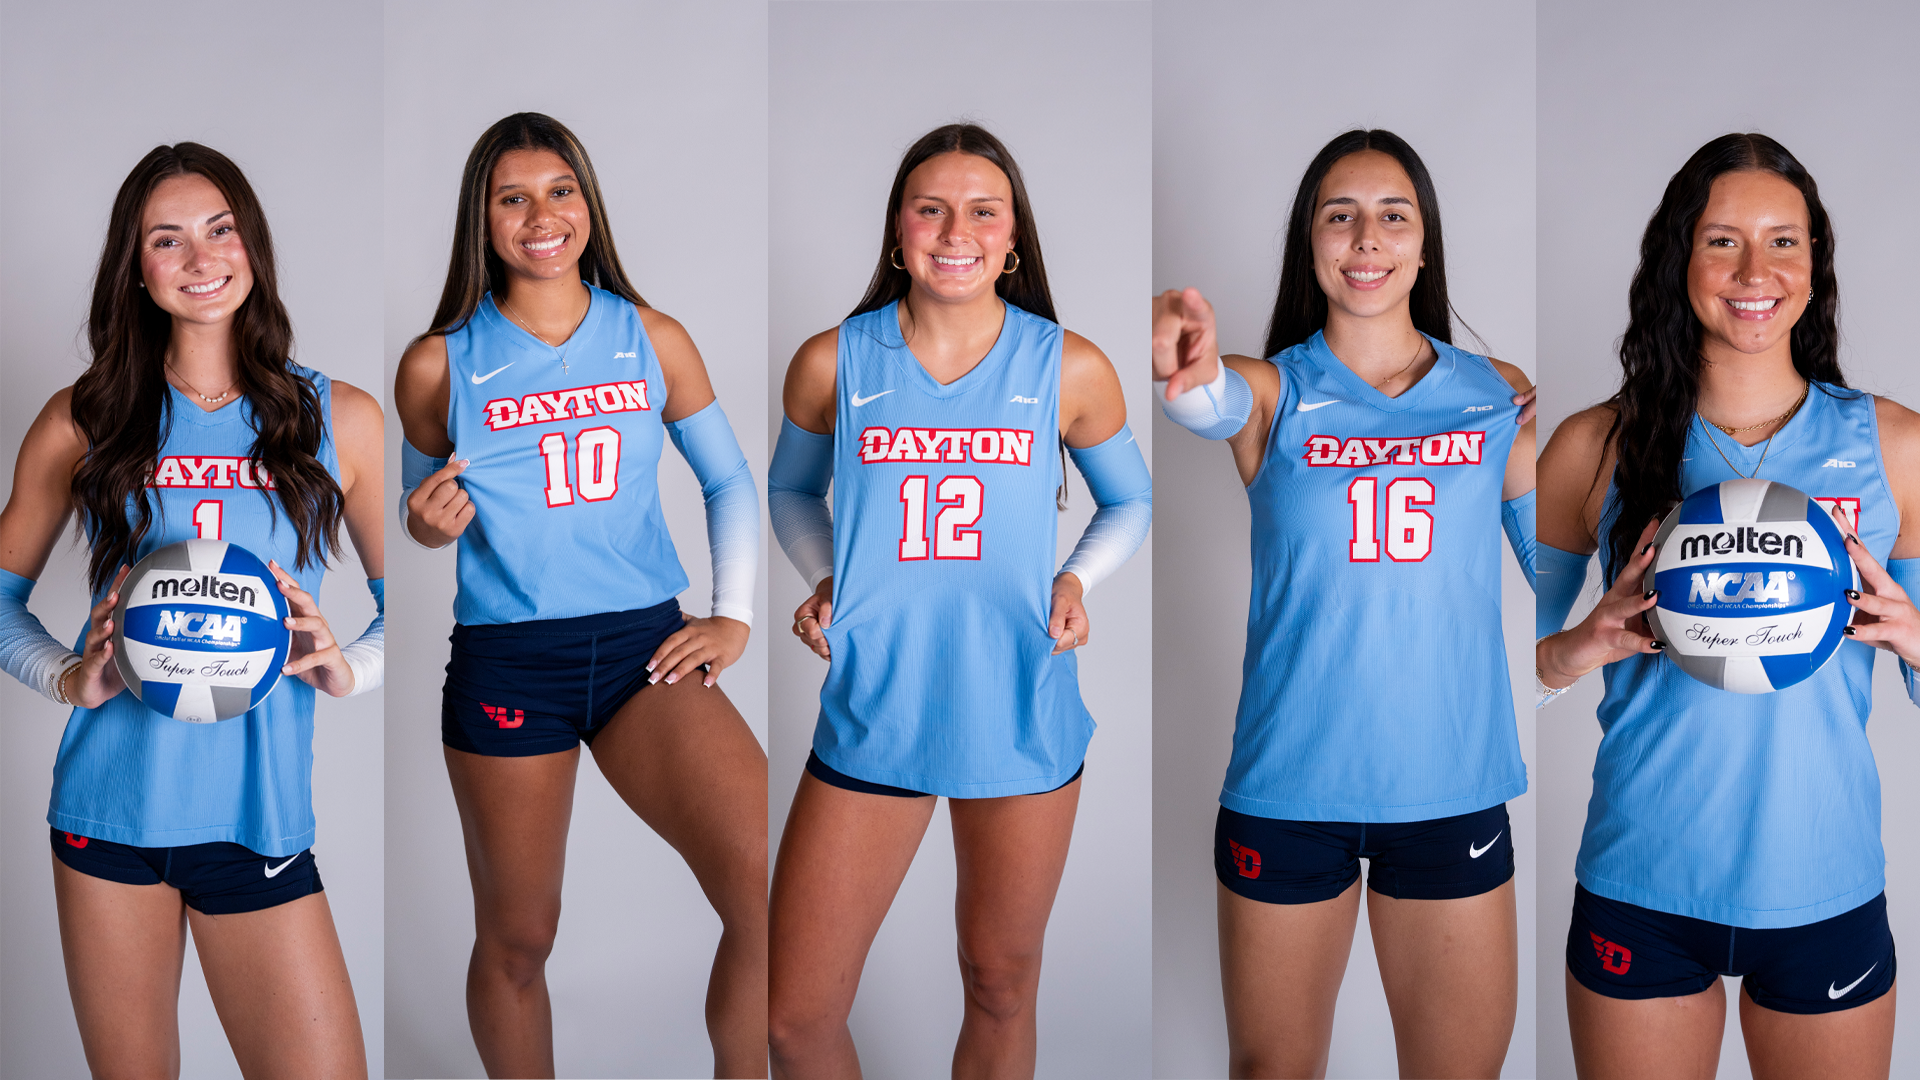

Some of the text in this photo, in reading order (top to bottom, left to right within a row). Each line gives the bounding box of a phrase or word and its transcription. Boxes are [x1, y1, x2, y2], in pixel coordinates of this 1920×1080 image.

[482, 379, 651, 432] DAYTON
[857, 426, 1034, 467] DAYTON
[1301, 430, 1486, 468] DAYTON
[144, 455, 279, 491] AYTO
[538, 425, 621, 508] 10
[192, 499, 223, 541] 1
[898, 474, 985, 562] 12
[1347, 476, 1435, 563] 16
[1680, 526, 1804, 561] molten
[151, 574, 256, 608] molten
[1685, 621, 1803, 649] Super Touch
[149, 653, 250, 677] Super Touch
